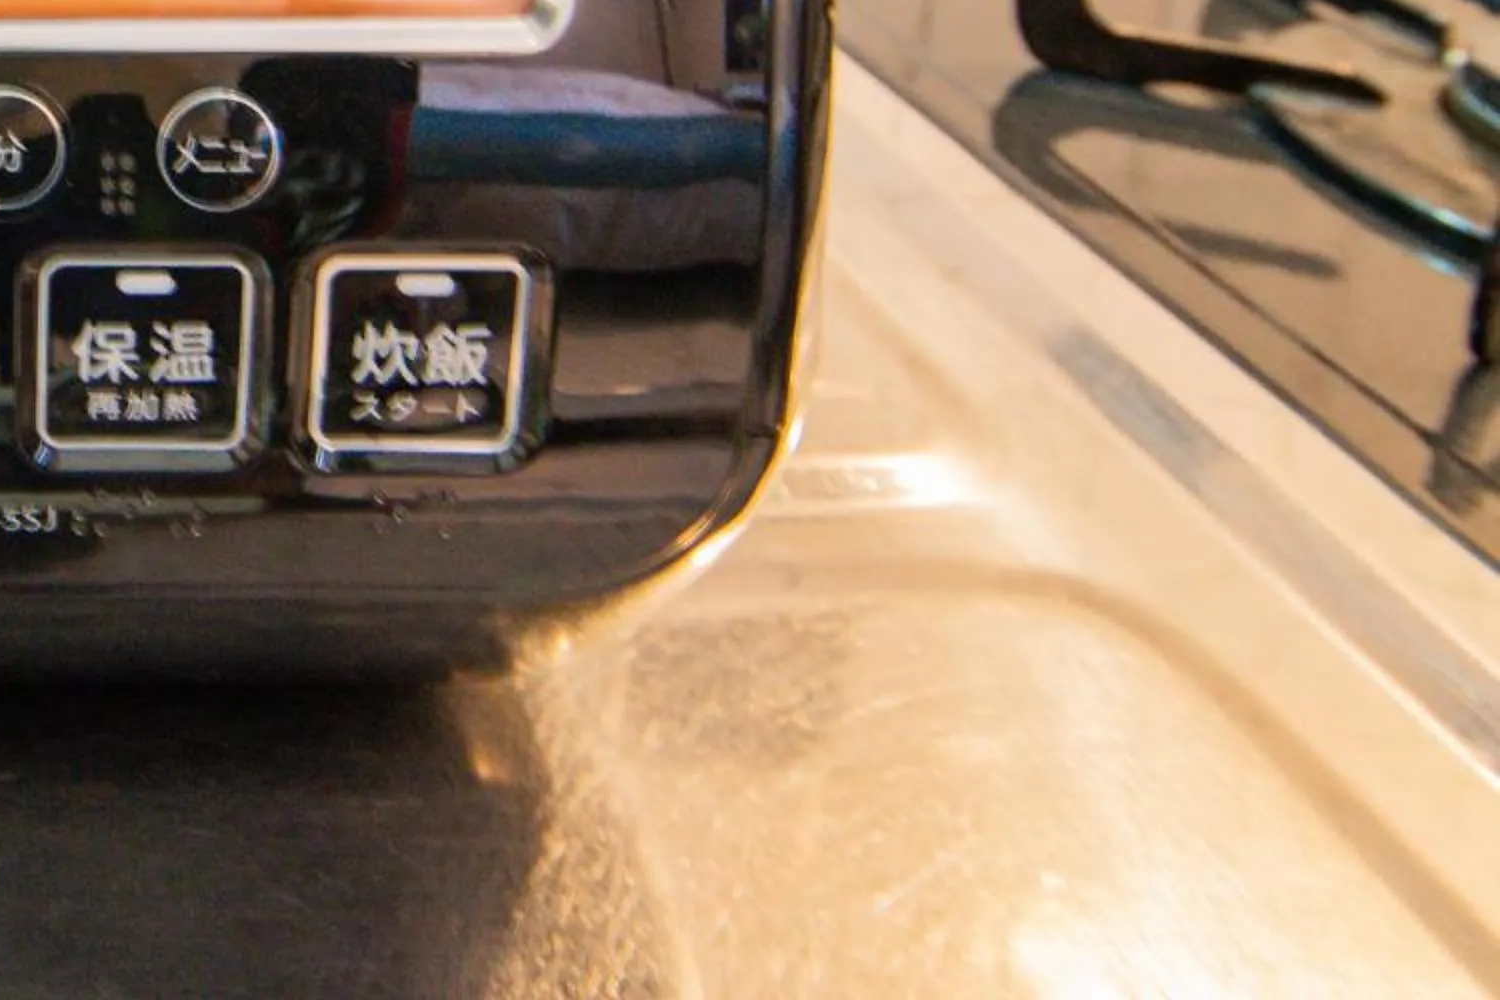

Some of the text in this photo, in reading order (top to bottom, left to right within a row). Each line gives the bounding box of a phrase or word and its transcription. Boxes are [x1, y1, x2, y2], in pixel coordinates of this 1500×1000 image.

[71, 319, 218, 384] 保温
[351, 319, 495, 387] 炊飯
[86, 390, 200, 422] 再加熱
[349, 391, 488, 422] スタート
